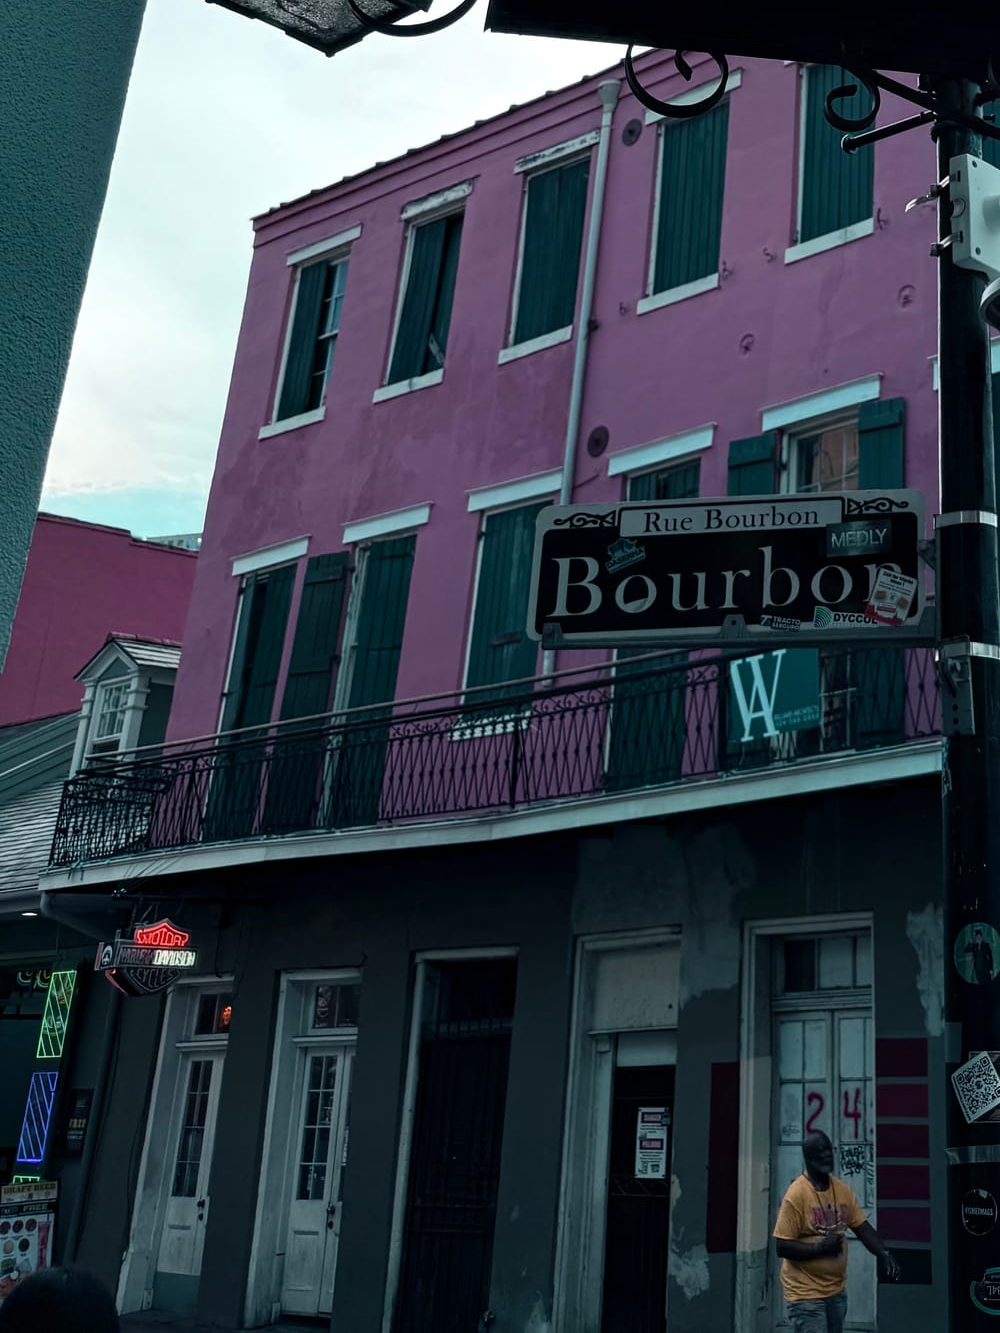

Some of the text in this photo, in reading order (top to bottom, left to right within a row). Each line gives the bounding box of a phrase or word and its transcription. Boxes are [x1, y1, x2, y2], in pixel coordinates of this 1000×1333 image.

[643, 506, 820, 534] Rue Bourbon
[831, 527, 888, 549] MEDLY
